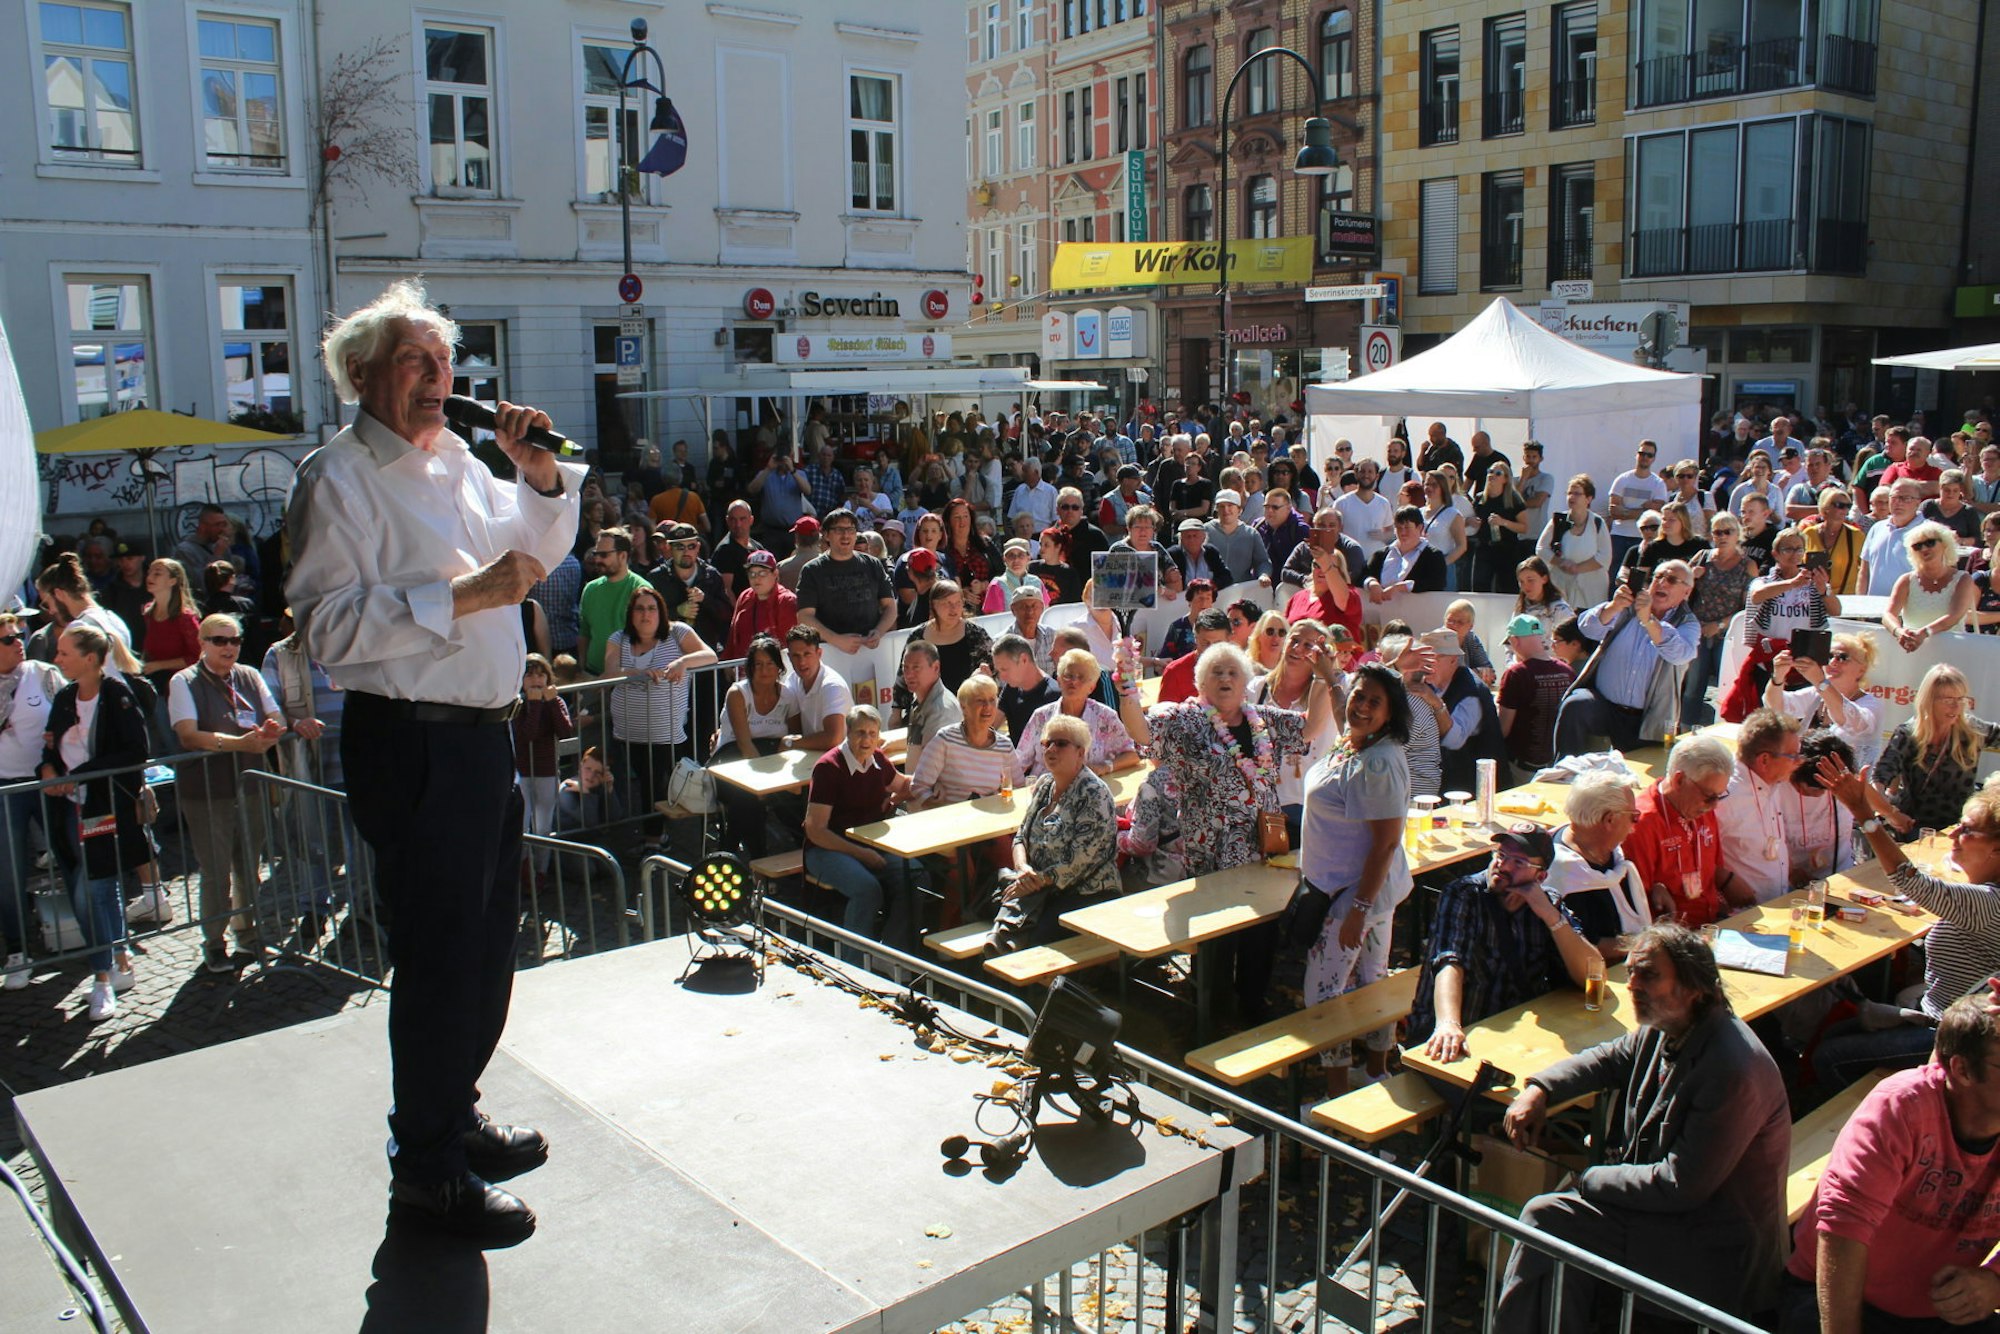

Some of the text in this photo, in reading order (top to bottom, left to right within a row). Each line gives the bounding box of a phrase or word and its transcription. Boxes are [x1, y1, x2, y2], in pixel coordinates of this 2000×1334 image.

[1135, 247, 1178, 272] Wir
[1308, 287, 1377, 298] Severinskirchplatz
[753, 299, 771, 310] Dom
[803, 291, 900, 317] Severin
[930, 300, 945, 310] Dom
[1111, 319, 1129, 331] ADAC
[1229, 324, 1286, 343] mallach
[621, 340, 635, 362] P
[1372, 343, 1387, 364] 20
